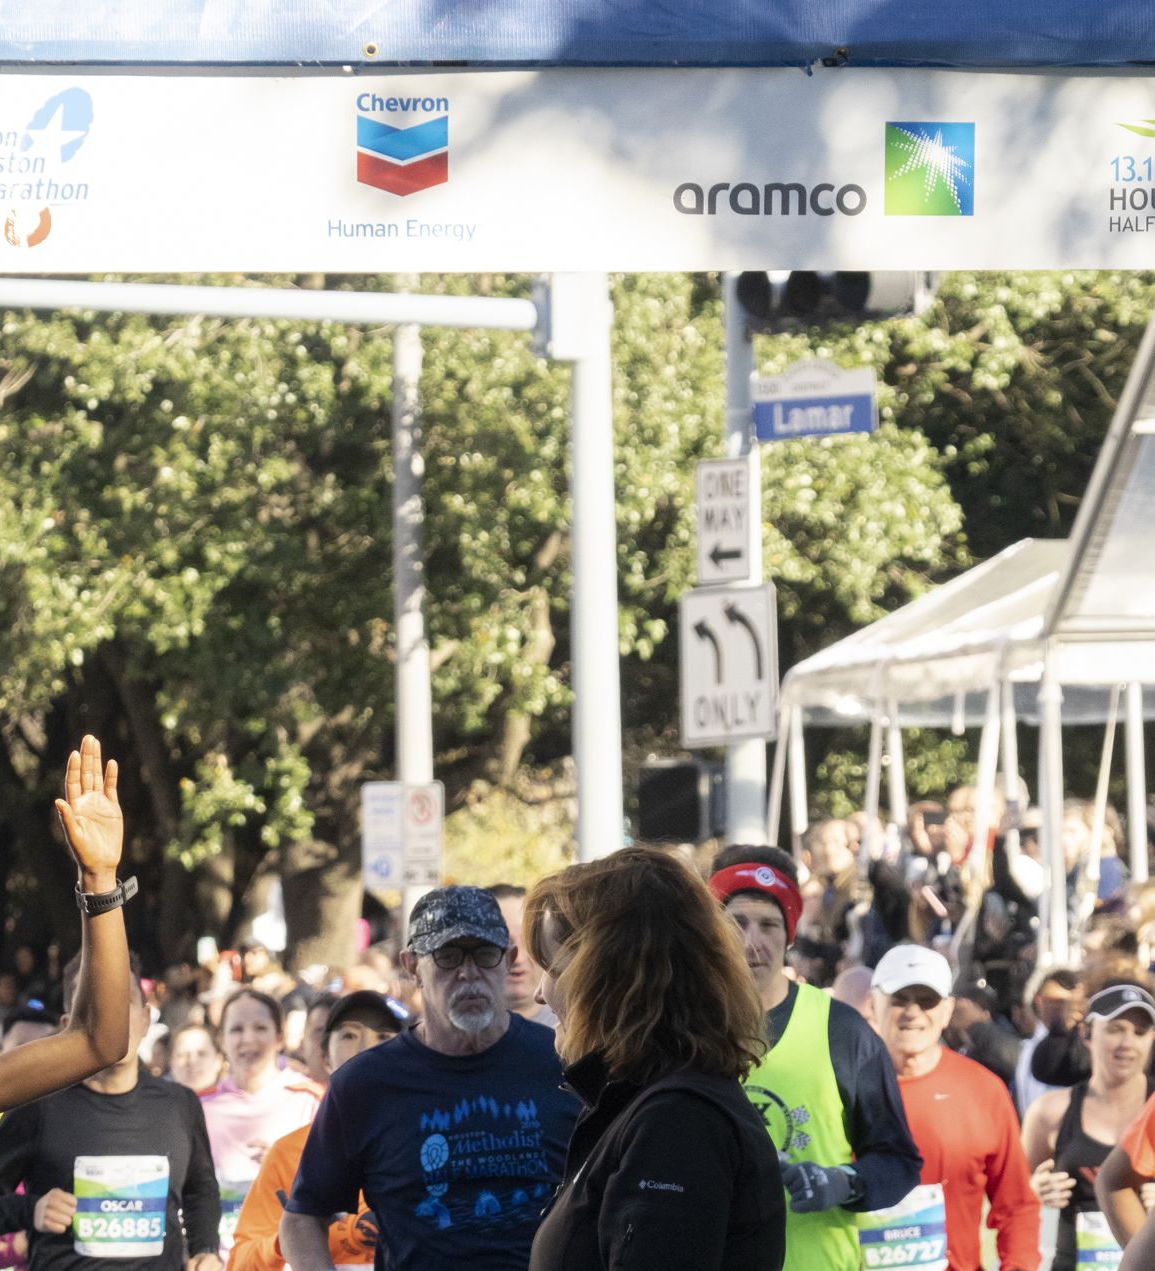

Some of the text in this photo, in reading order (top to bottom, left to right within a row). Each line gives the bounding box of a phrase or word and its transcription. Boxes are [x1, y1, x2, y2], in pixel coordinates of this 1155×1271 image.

[357, 93, 449, 112] Chevron
[1110, 156, 1152, 182] 13.1
[673, 182, 868, 217] aramco
[328, 219, 398, 238] Human
[1109, 216, 1155, 232] HALF
[773, 402, 855, 434] Lamar
[705, 471, 744, 498] ONE
[704, 508, 743, 533] WAY
[695, 691, 762, 730] ONLY
[451, 1130, 542, 1155] Methodist
[450, 1150, 547, 1168] THE WOODLANDS
[465, 1158, 550, 1178] MARATHON
[647, 1180, 684, 1193] Columbia
[100, 1200, 144, 1213] OSCAR
[78, 1217, 162, 1239] B26885
[884, 1226, 921, 1241] BRUCE
[865, 1239, 944, 1268] B26727
